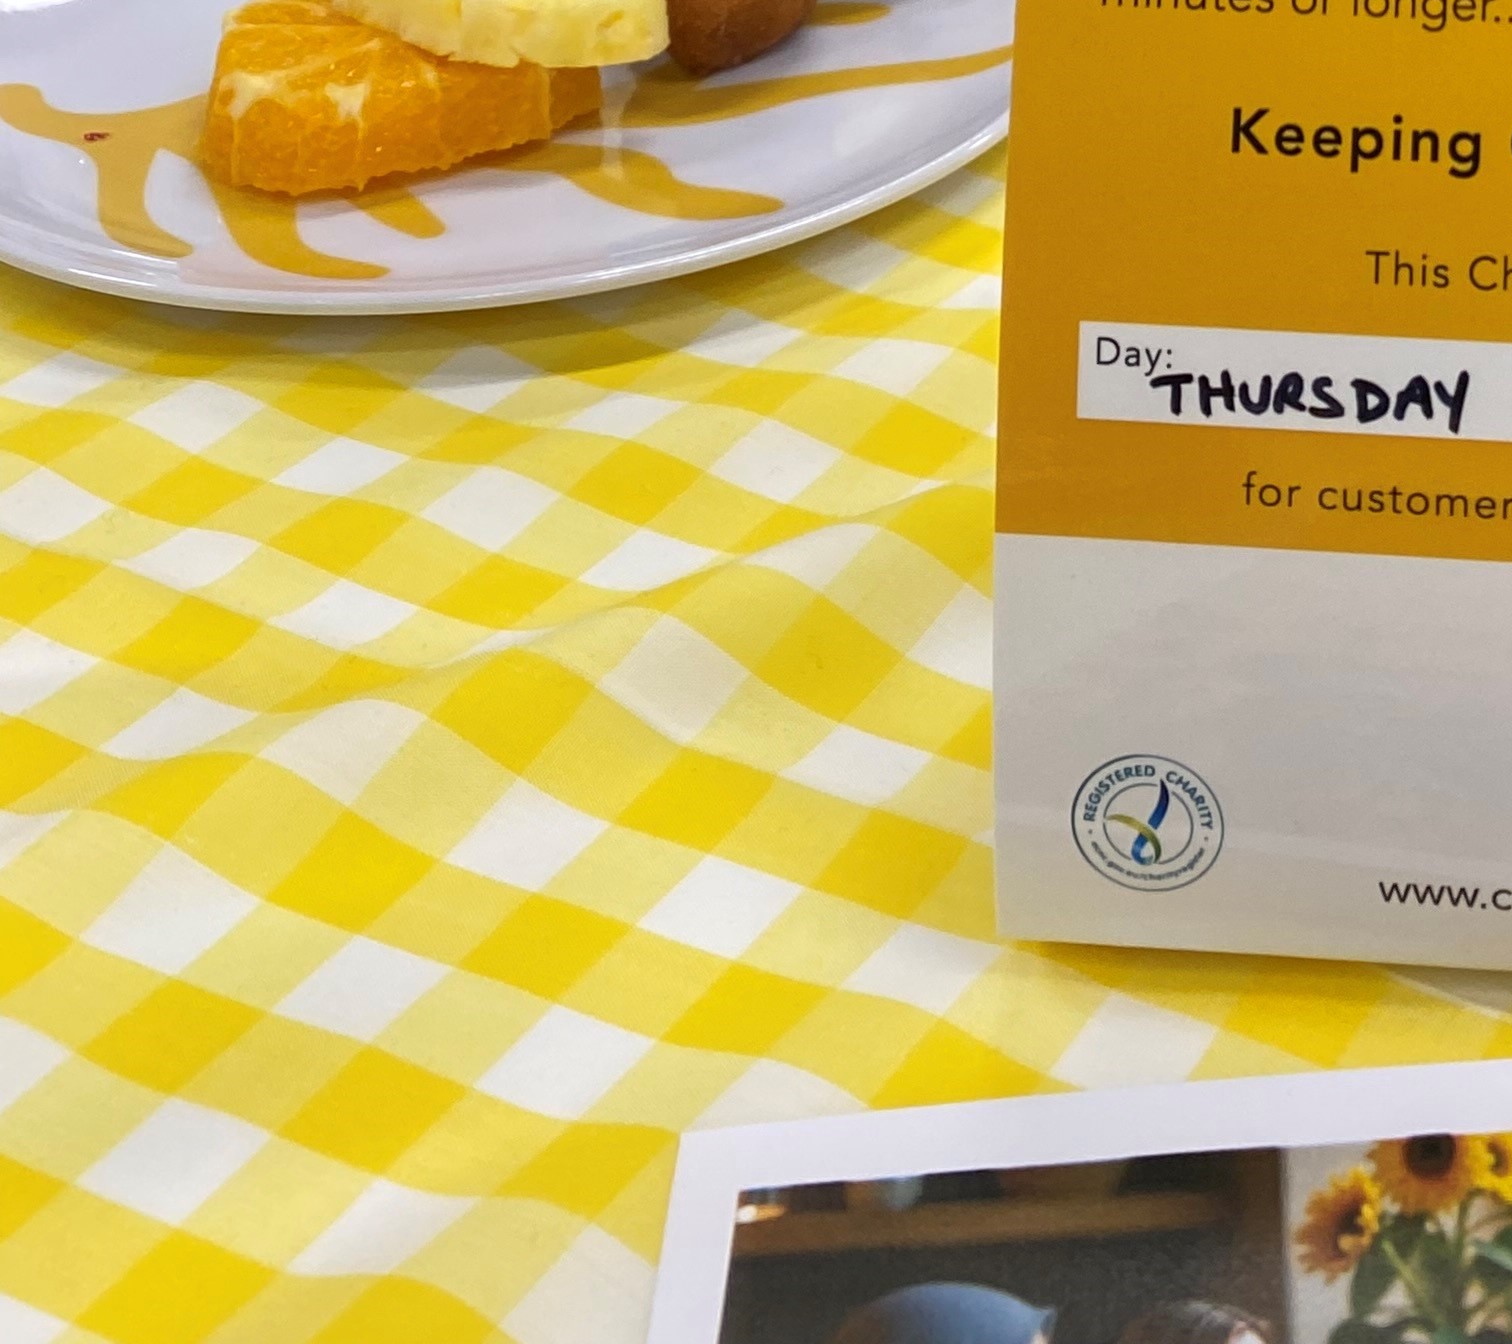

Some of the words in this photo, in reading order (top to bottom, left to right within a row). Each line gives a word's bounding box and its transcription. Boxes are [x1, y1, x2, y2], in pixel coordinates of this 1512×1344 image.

[1229, 107, 1483, 179] Keeping
[1364, 249, 1450, 290] This
[1095, 336, 1174, 377] Day:
[1150, 369, 1471, 433] THURSDAY
[1241, 471, 1300, 508] for
[1083, 764, 1156, 822] REGISTERED
[1166, 771, 1213, 830] CHARITY
